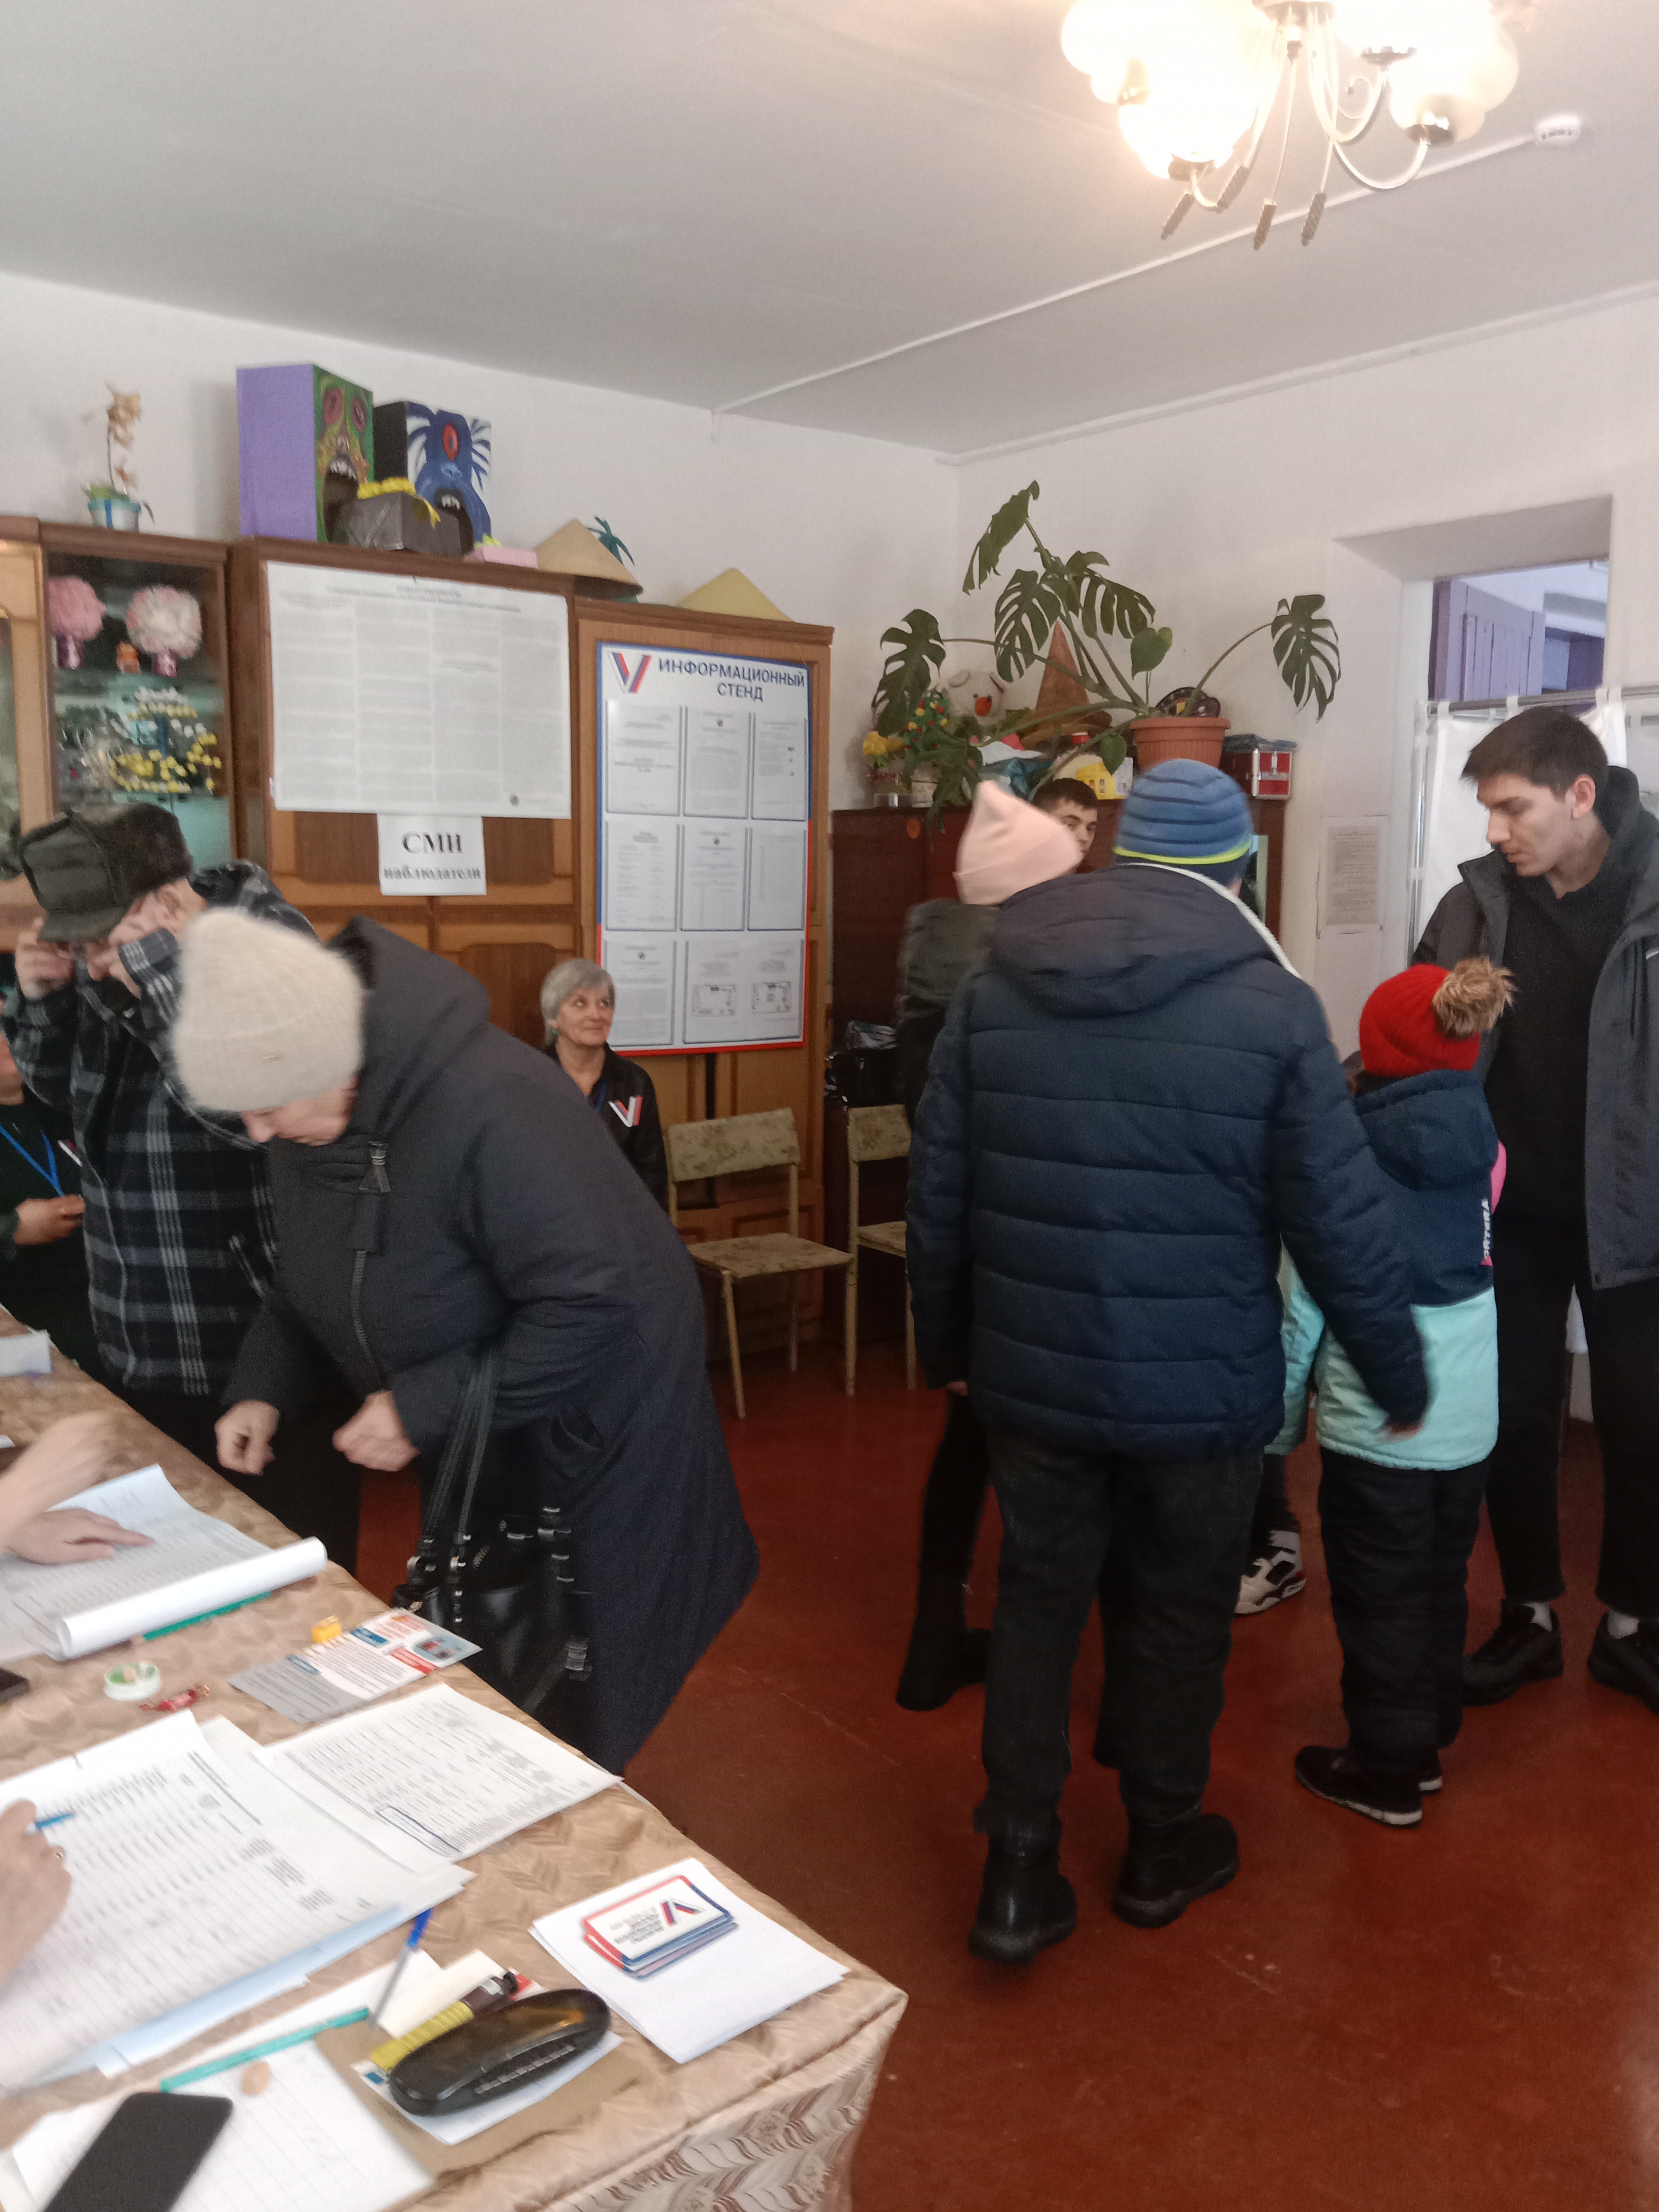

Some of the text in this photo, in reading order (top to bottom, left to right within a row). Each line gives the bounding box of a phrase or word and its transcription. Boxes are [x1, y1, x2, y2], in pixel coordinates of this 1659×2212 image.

[658, 657, 805, 688] ИНФОРМАЦИОННЫЙ
[718, 683, 763, 702] СТЕНД
[403, 831, 463, 854] СМИ
